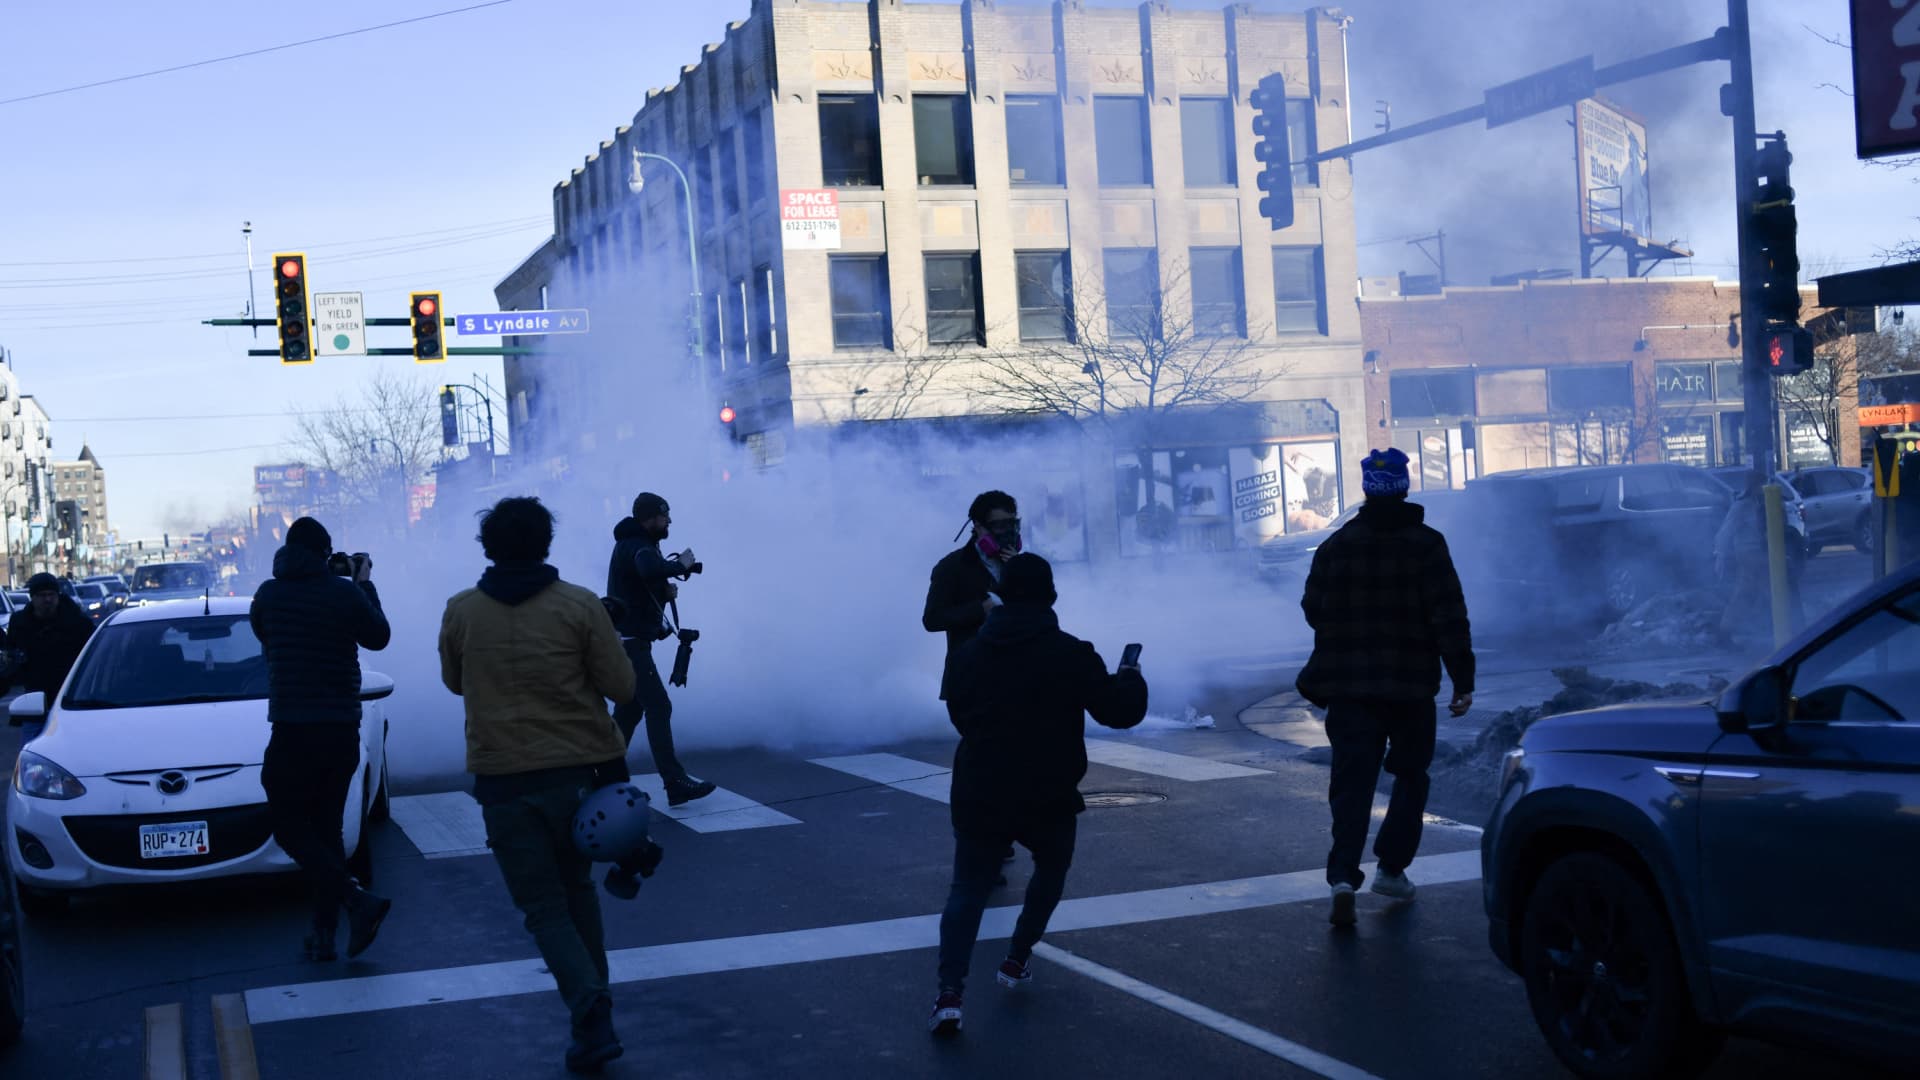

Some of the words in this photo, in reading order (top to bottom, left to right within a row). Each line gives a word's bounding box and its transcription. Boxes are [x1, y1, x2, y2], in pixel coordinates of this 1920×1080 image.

[789, 193, 832, 204] SPACE
[784, 205, 805, 218] FOR
[807, 205, 838, 218] LEASE
[318, 297, 336, 306] LEFT
[340, 296, 359, 305] TURN
[327, 308, 352, 319] YIELD
[321, 323, 333, 332] ON
[335, 321, 359, 331] GREEN
[464, 318, 476, 331] S
[483, 317, 550, 333] Lyndale
[559, 316, 580, 328] Av
[1656, 375, 1705, 392] HAIR
[1238, 472, 1275, 491] HARAZ
[1236, 487, 1279, 506] COMING
[1244, 503, 1274, 521] SOON
[144, 833, 168, 850] RUP
[179, 830, 203, 848] 274
